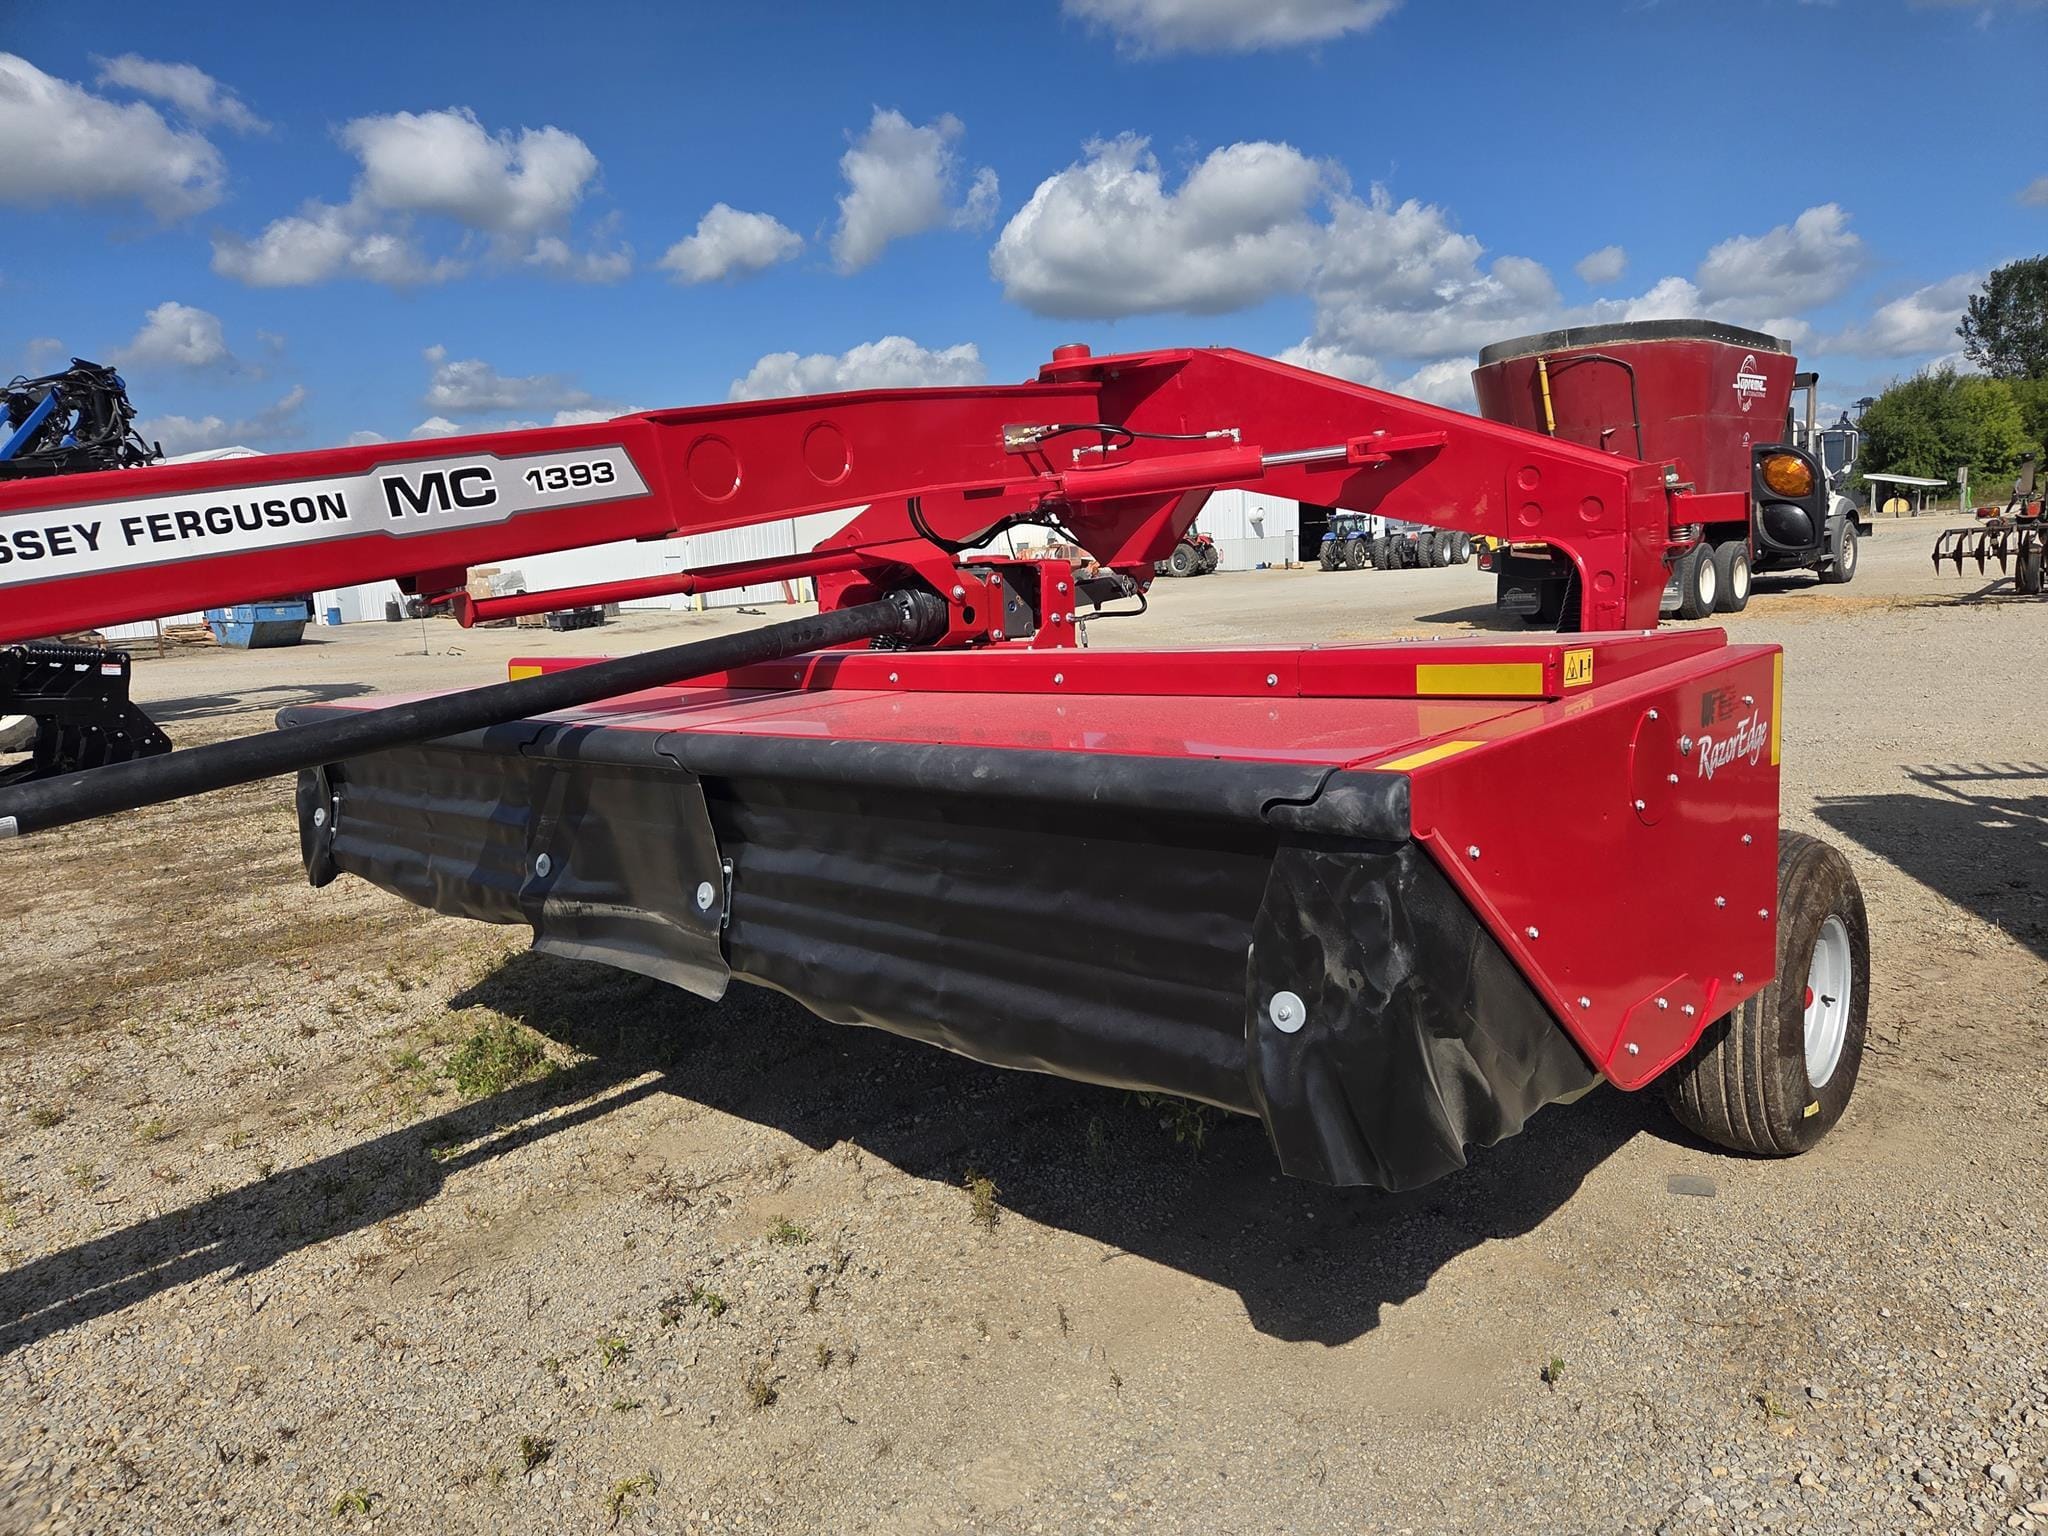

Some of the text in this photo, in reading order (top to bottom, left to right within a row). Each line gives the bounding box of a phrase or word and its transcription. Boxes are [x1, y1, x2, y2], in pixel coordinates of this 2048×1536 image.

[382, 462, 615, 517] MC 1393
[120, 492, 348, 547] FERGUSON
